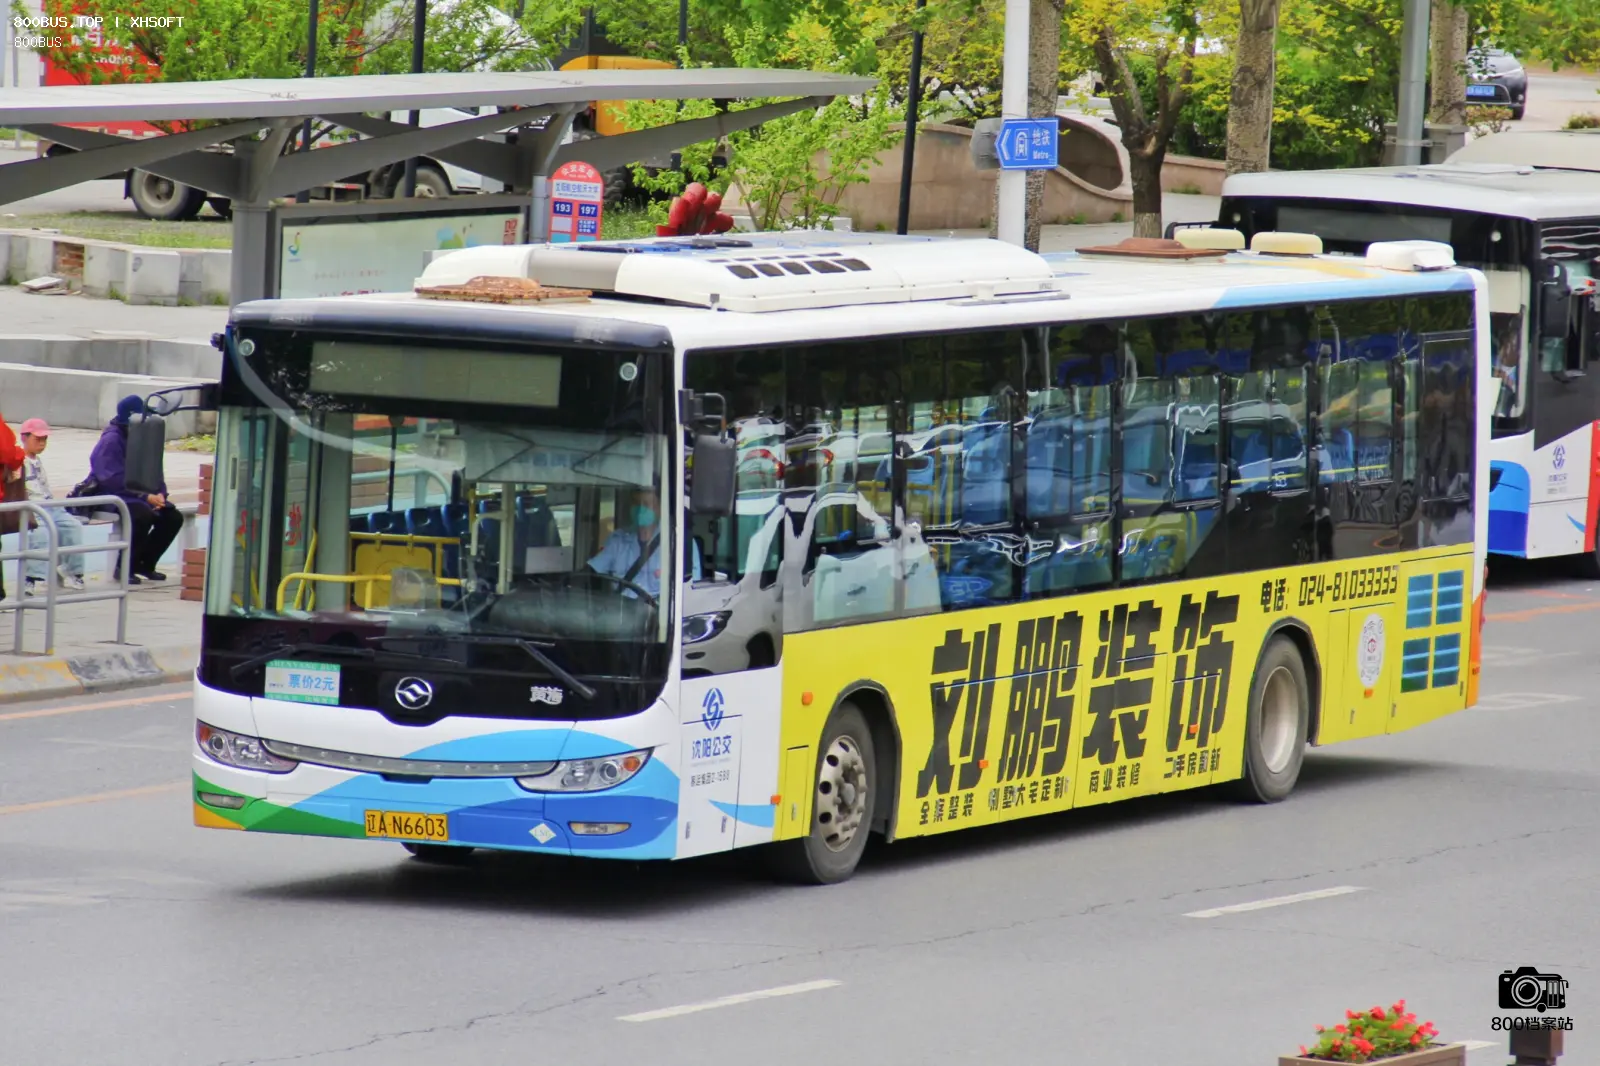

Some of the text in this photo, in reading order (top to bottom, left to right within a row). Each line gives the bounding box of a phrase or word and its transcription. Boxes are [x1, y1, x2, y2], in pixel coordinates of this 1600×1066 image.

[555, 203, 597, 216] 193 197
[1298, 565, 1399, 607] 024-81033333
[287, 673, 336, 692] 票价2元
[916, 590, 1240, 799] 刘鹏装饰
[691, 735, 732, 759] 沈阳公交
